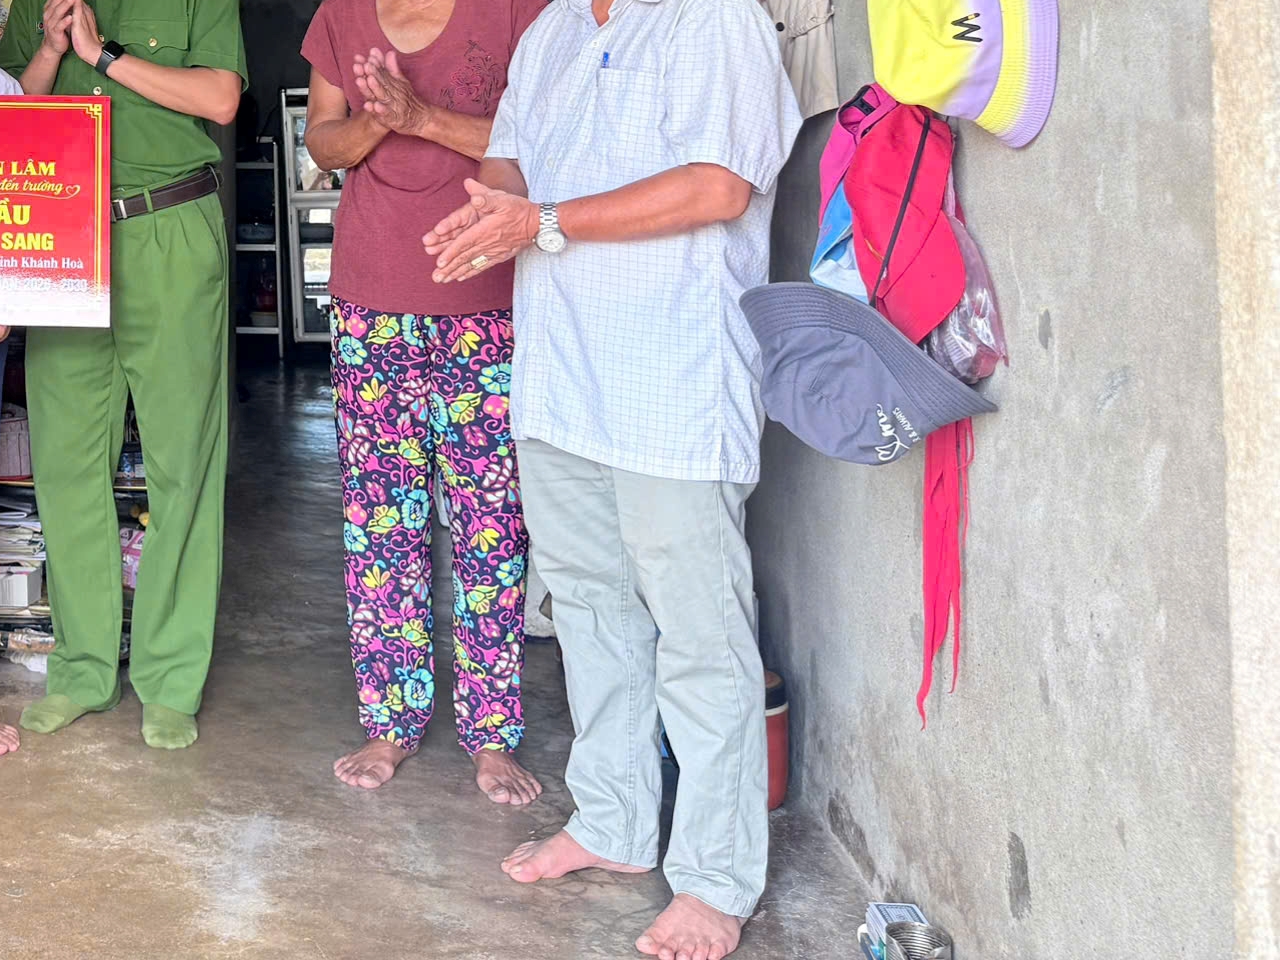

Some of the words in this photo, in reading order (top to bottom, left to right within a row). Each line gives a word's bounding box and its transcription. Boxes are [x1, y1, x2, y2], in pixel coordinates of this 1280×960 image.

[11, 159, 56, 176] LÂM
[23, 179, 63, 195] trường
[1, 232, 54, 250] SANG
[21, 256, 59, 269] Khánh
[61, 257, 84, 269] Hoà
[892, 407, 914, 431] ALWAYS
